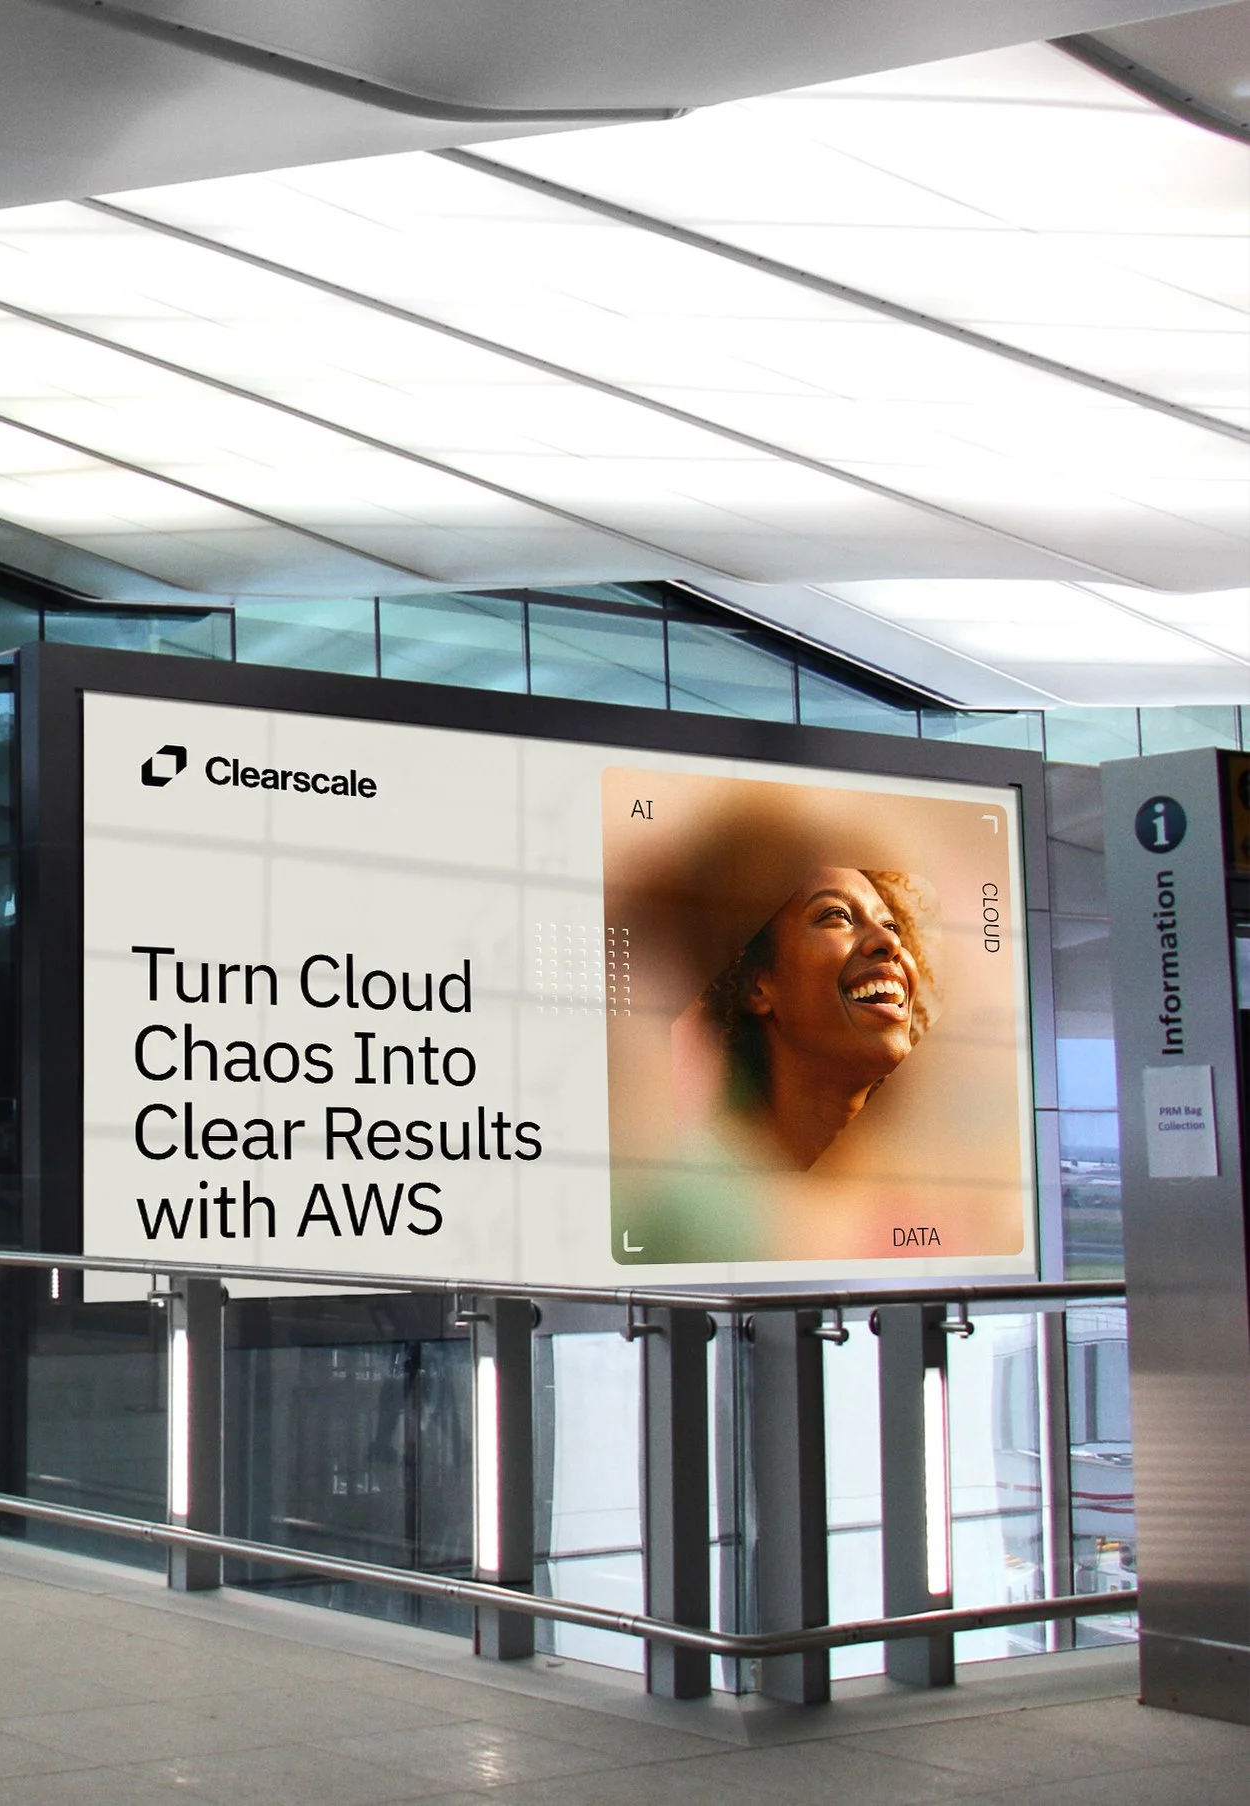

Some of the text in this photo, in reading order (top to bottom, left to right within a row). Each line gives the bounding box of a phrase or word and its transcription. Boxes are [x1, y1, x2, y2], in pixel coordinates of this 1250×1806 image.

[205, 756, 378, 799] Clearscale
[630, 799, 654, 820] AI
[981, 882, 1001, 953] CLOUD
[131, 945, 472, 1014] Turn Cloud
[1152, 869, 1184, 1055] Information
[134, 1023, 477, 1087] Chaos Into
[135, 1101, 542, 1161] Clear Results
[1158, 1121, 1205, 1131] Collection
[1159, 1106, 1202, 1116] PRM Bag
[136, 1180, 443, 1240] with AWS
[893, 1227, 941, 1247] DATA
